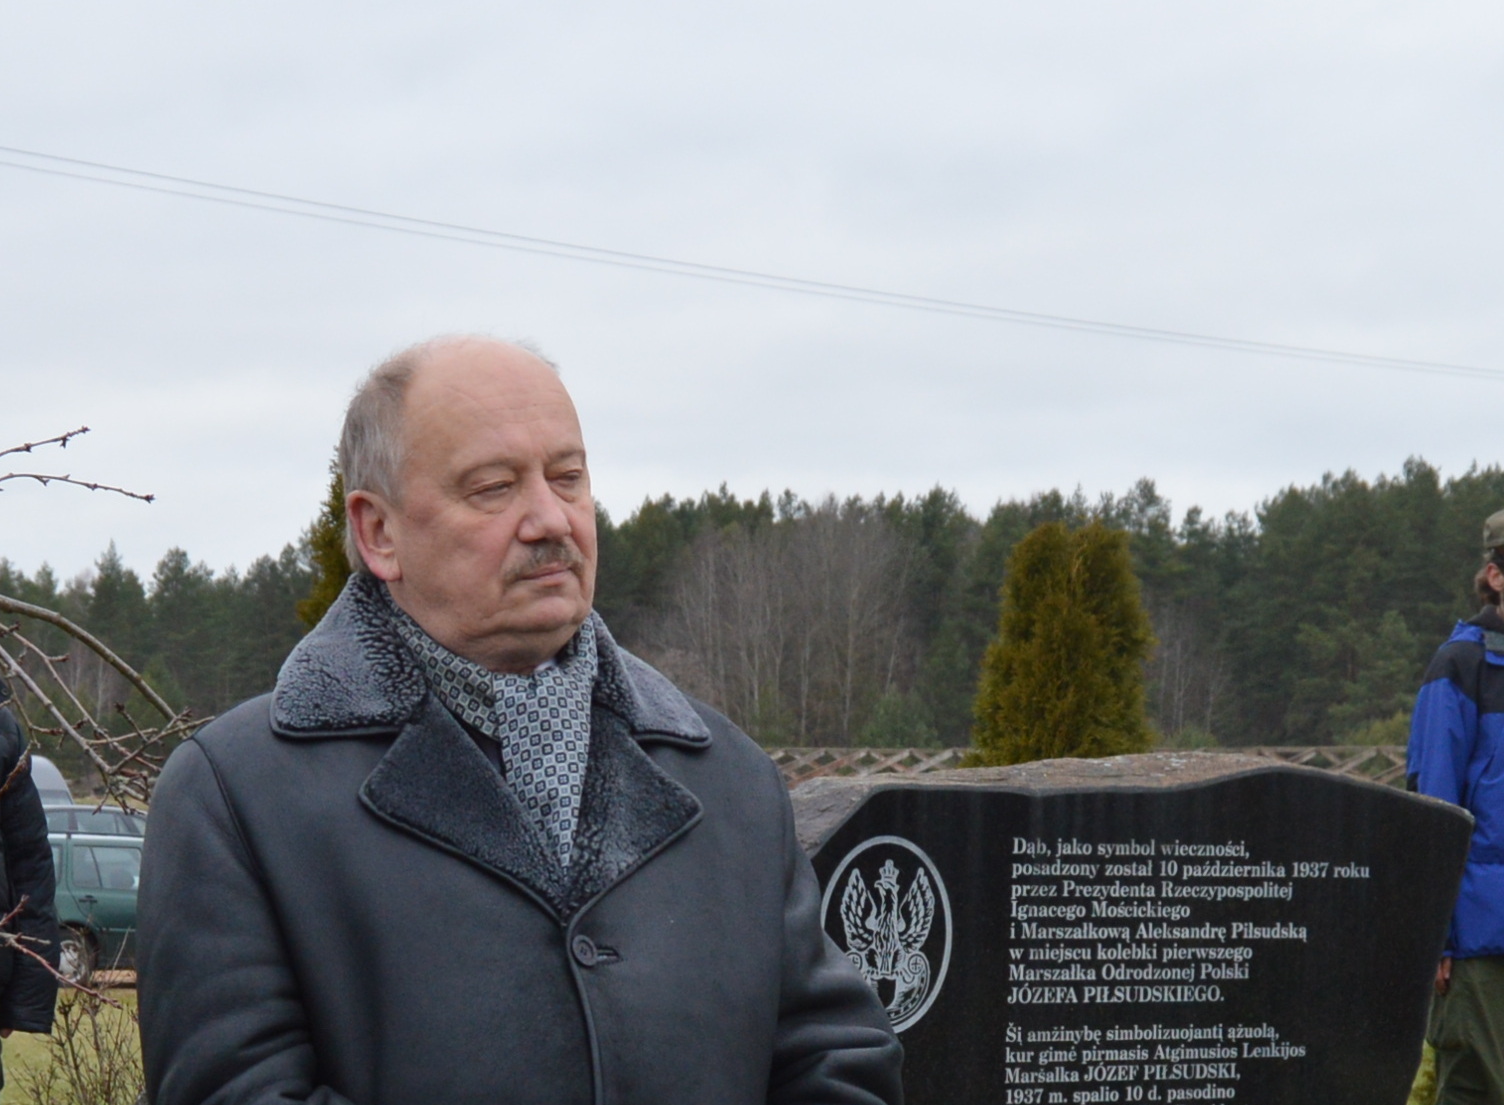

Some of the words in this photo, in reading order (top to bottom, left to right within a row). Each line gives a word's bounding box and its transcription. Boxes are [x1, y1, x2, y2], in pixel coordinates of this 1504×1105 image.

[1012, 837, 1051, 858] Dąb,
[1056, 838, 1092, 857] jako
[1097, 839, 1155, 858] symbol
[1161, 839, 1249, 859] wieczności,
[1012, 860, 1099, 878] posadzony
[1105, 860, 1152, 876] został
[1159, 860, 1177, 876] 10
[1183, 860, 1286, 879] października
[1292, 862, 1329, 878] 1937
[1333, 862, 1370, 878] roku
[1011, 884, 1057, 899] przez
[1063, 880, 1155, 899] Prezydenta
[1161, 881, 1293, 900] Rzeczypospolitej
[1010, 901, 1086, 920] Ignacego
[1091, 901, 1190, 920] Mościckiego
[1010, 922, 1015, 938] i
[1021, 922, 1130, 942] Marszałkową
[1135, 922, 1227, 942] Aleksandrę
[1231, 922, 1307, 942] Piłsudską
[1009, 948, 1024, 959] w
[1029, 943, 1091, 962] miejscu
[1097, 943, 1157, 959] kolebki
[1162, 943, 1253, 962] pierwszego
[1009, 964, 1096, 981] Marszałka
[1102, 963, 1195, 982] Odrodzonej
[1200, 963, 1249, 979] Polski
[1007, 983, 1078, 1003] JÓZEFA
[1083, 985, 1224, 1002] PIŁSUDSKIEGO.
[1005, 1022, 1022, 1046] Šį
[1027, 1025, 1101, 1044] amžinybę
[1106, 1024, 1223, 1042] simbolizuojantį
[1228, 1023, 1279, 1042] ąžuolą,
[1005, 1047, 1034, 1063] kur
[1039, 1046, 1077, 1065] gimė
[1082, 1045, 1148, 1064] pirmasis
[1153, 1044, 1237, 1062] Atgimusios
[1242, 1042, 1306, 1060] Lenkijos
[1005, 1067, 1079, 1083] Maršalka
[1084, 1062, 1139, 1081] JÓZEF
[1144, 1063, 1240, 1080] PIŁSUDSKI,
[1005, 1088, 1043, 1104] 1937
[1048, 1092, 1067, 1103] m.
[1073, 1086, 1119, 1105] spalio
[1126, 1086, 1143, 1101] 10
[1148, 1085, 1161, 1100] d.
[1167, 1084, 1235, 1102] pasodino
